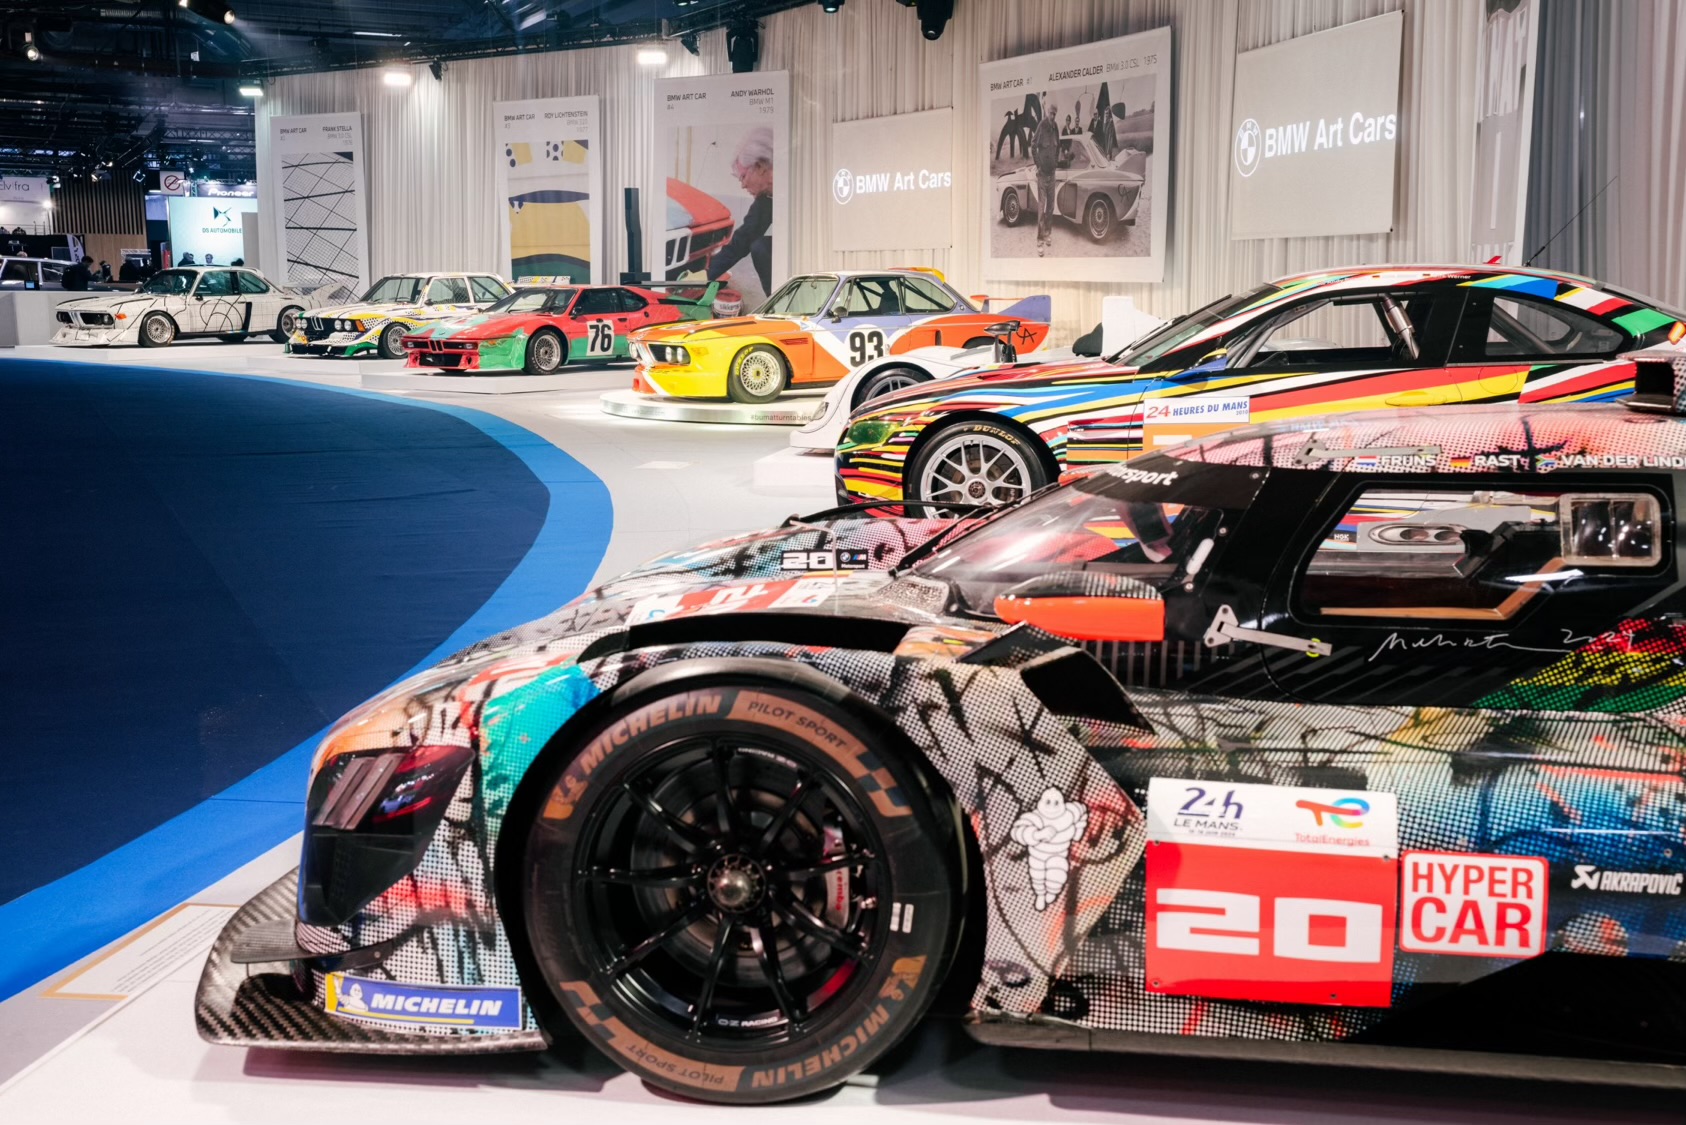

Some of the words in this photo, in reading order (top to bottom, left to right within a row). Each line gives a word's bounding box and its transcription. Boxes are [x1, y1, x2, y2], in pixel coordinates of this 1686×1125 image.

[1049, 68, 1082, 82] ALEXANDER
[1082, 65, 1104, 78] CALDER
[1106, 62, 1120, 73] BMW
[1143, 54, 1158, 66] 1975
[748, 88, 775, 97] WARHOL
[990, 83, 1002, 92] BMW
[1002, 80, 1012, 89] ART
[1013, 79, 1024, 88] CAR
[667, 94, 681, 102] BMW
[682, 93, 694, 101] ART
[695, 92, 707, 100] CAR
[749, 98, 764, 106] BMW
[554, 111, 589, 119] LICHTENSTEIN
[759, 106, 774, 114] 1979
[1265, 121, 1310, 158] BMW
[1314, 118, 1344, 150] Art
[1349, 112, 1397, 145] Cars
[208, 188, 254, 197] Pioneer
[856, 173, 890, 194] BMW
[894, 172, 915, 191] Art
[918, 169, 952, 189] Cars
[589, 324, 612, 352] 76
[850, 331, 884, 368] 93
[1146, 405, 1171, 419] 24
[1172, 405, 1205, 417] HEURES
[1207, 404, 1220, 413] DU
[1222, 401, 1248, 412] MANS
[973, 425, 1020, 445] DUNLOP
[1474, 455, 1521, 467] RAST
[1561, 455, 1599, 466] VAN
[1603, 456, 1639, 466] DER
[1642, 457, 1686, 468] LIND
[783, 552, 837, 570] 20
[579, 694, 723, 776] MICHELIN
[748, 700, 795, 721] PILOT
[796, 716, 848, 749] SPORT
[1177, 787, 1244, 820] 24h
[1174, 817, 1192, 827] LE
[1295, 833, 1370, 847] TotalEnergies
[835, 870, 845, 912] rembo
[1411, 862, 1534, 900] HYPER
[1156, 888, 1383, 963] 20
[1410, 896, 1532, 949] CAR
[371, 993, 503, 1017] MICHELIN
[751, 1004, 892, 1089] MICHELIN
[626, 1043, 678, 1073] SPORT
[675, 1069, 725, 1085] PILOT
